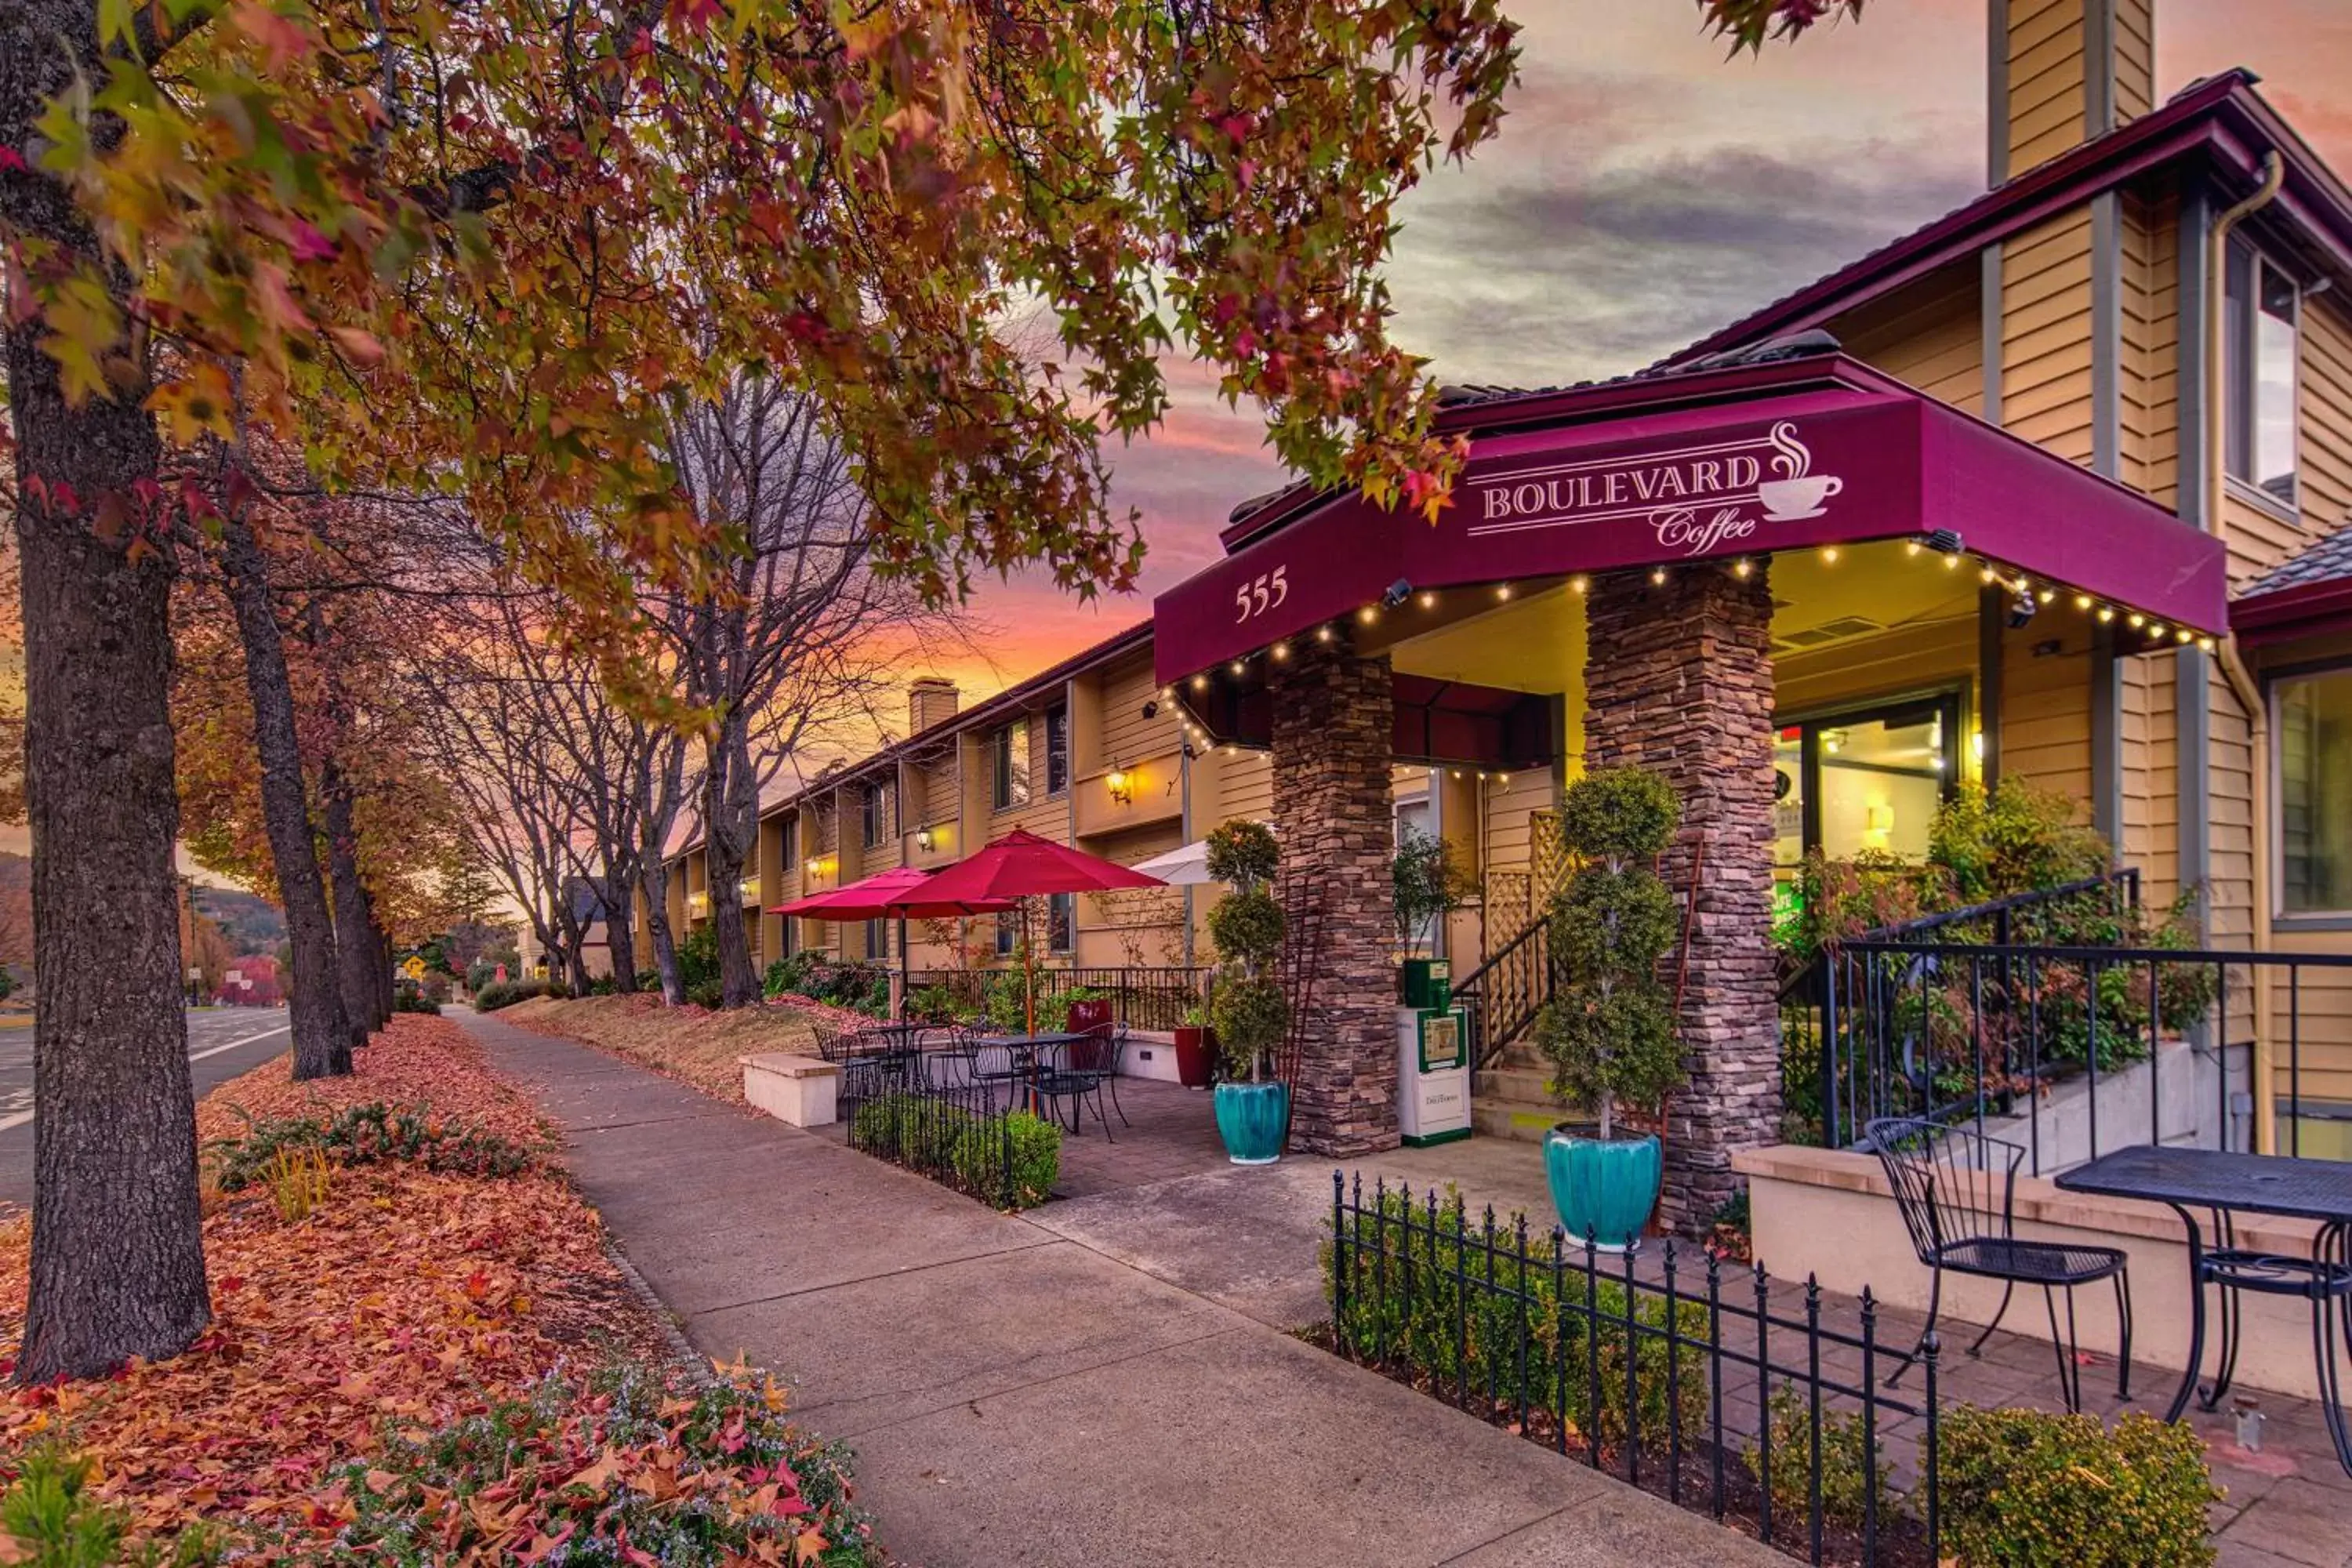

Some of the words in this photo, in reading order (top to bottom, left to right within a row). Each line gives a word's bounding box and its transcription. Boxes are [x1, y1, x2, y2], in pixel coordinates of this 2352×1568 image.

[1483, 456, 1760, 519] BOULEVARD
[1649, 507, 1756, 557] Coffee
[1236, 564, 1288, 624] 555
